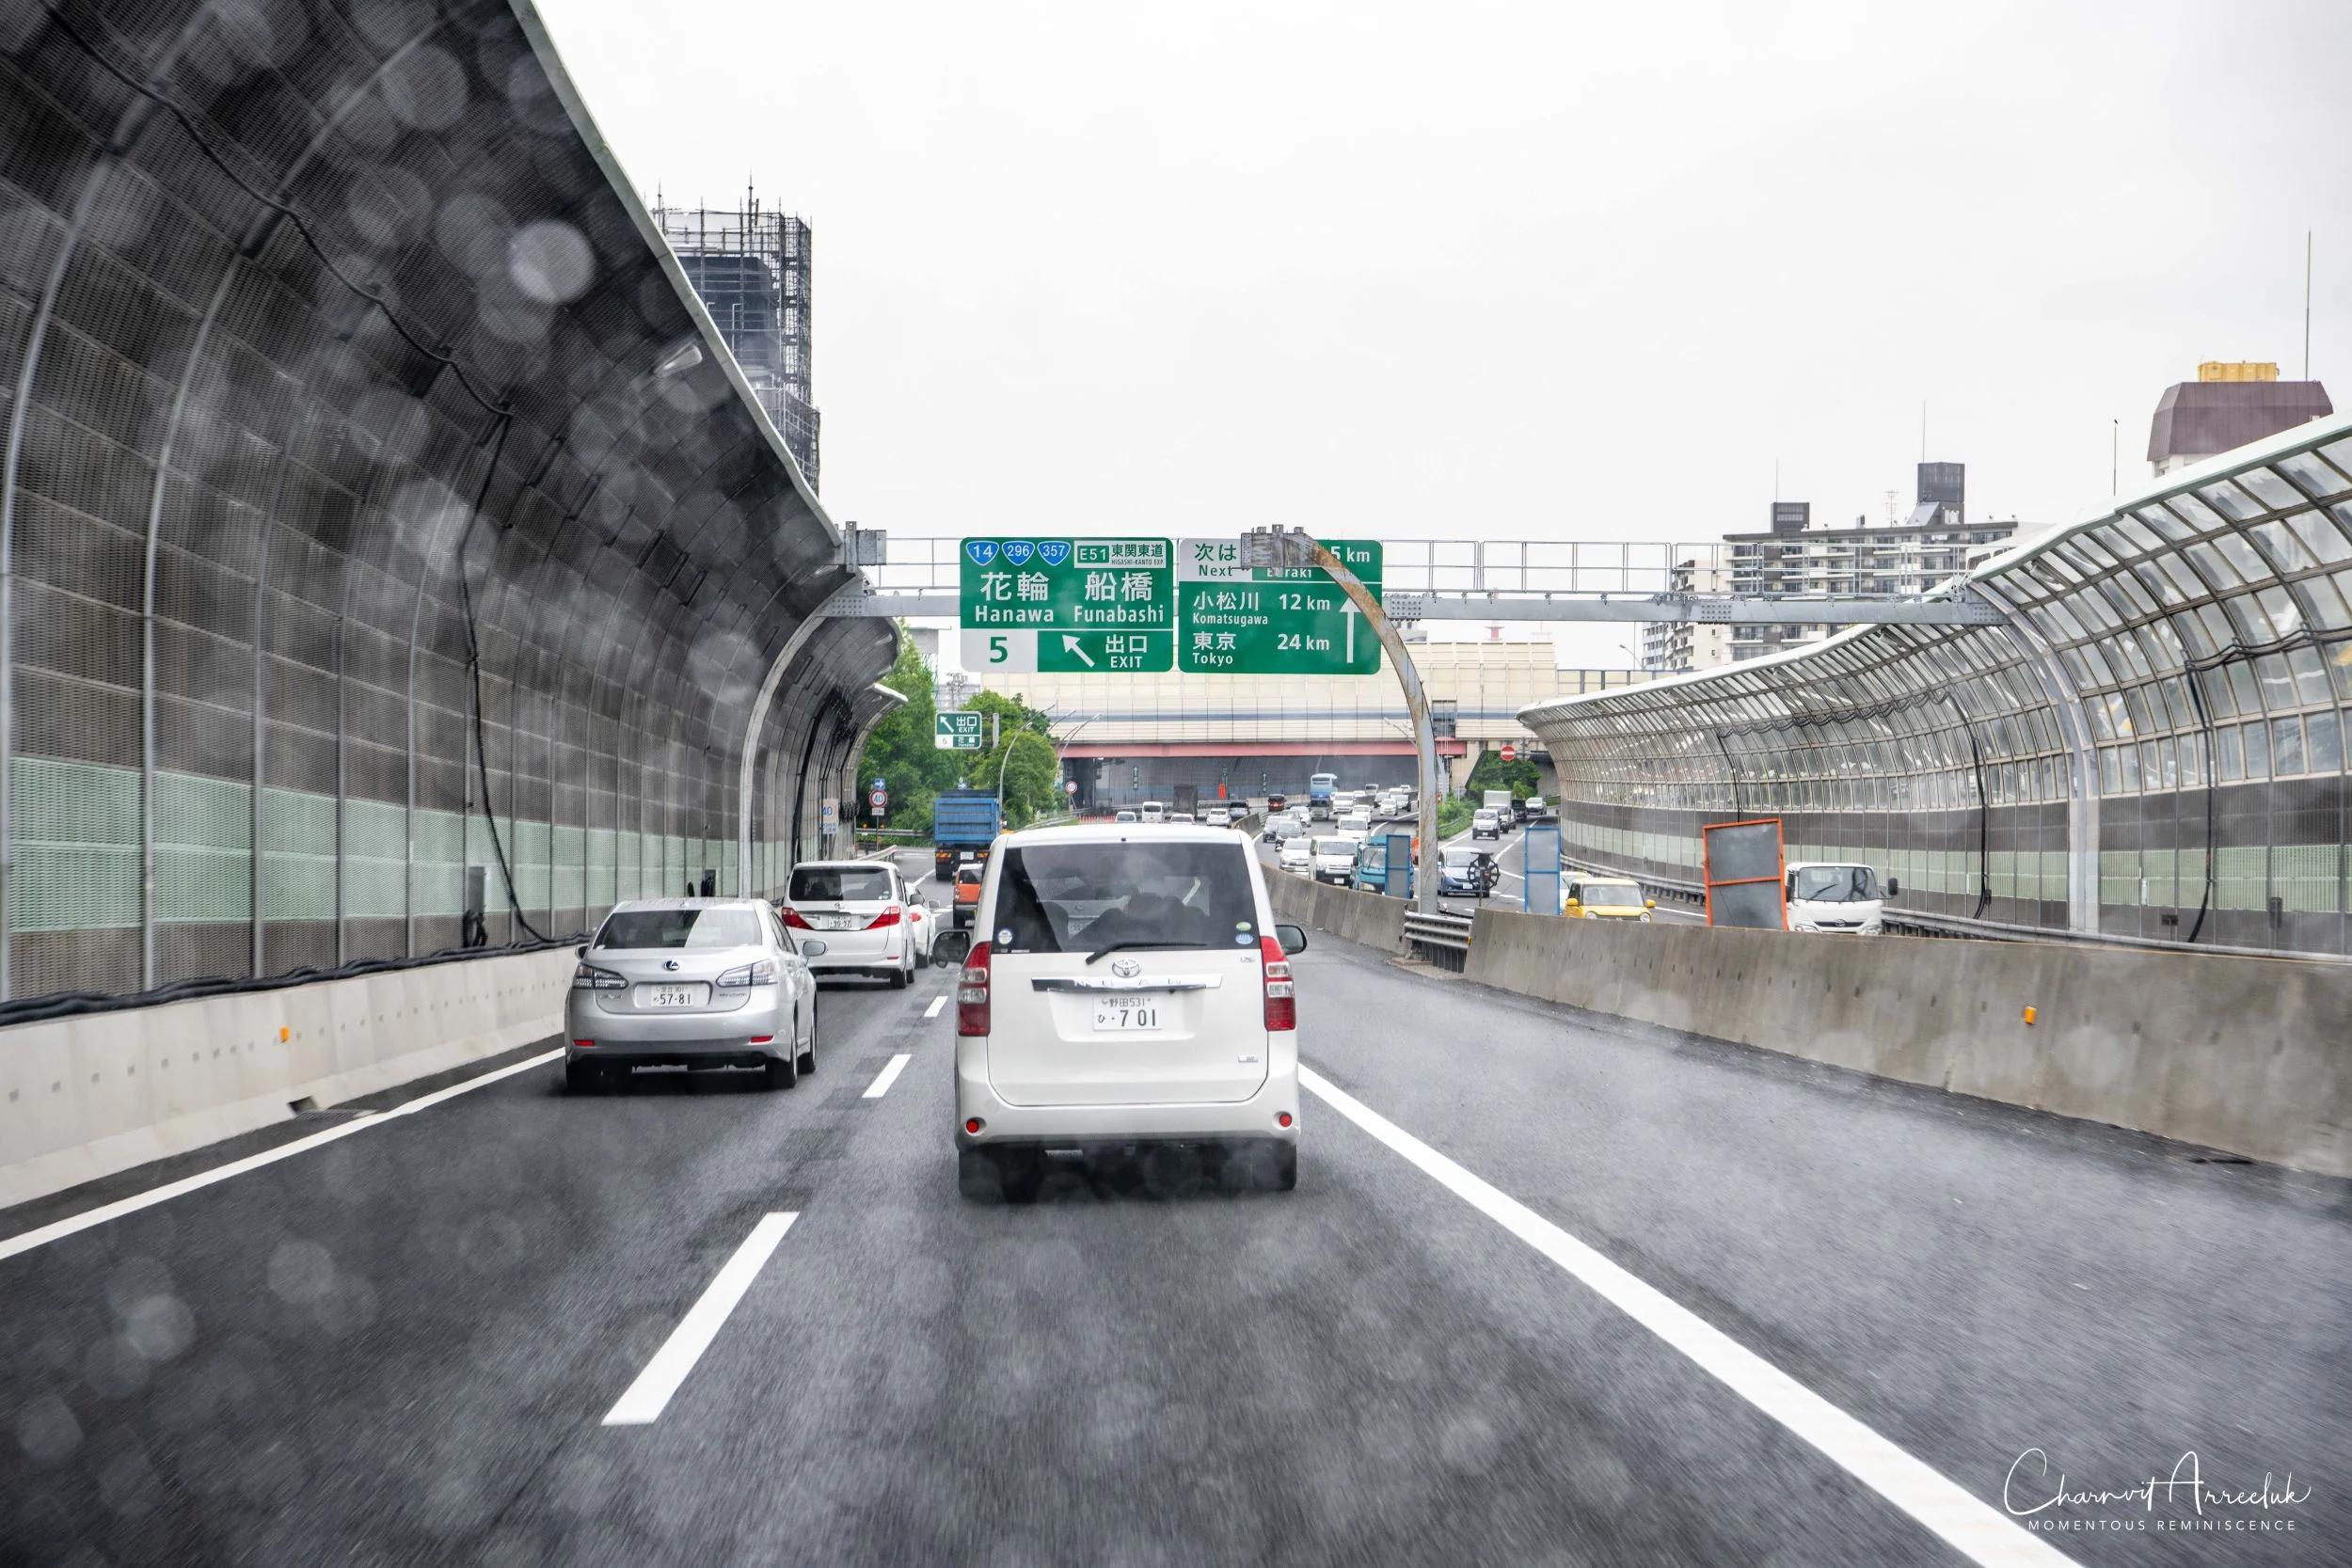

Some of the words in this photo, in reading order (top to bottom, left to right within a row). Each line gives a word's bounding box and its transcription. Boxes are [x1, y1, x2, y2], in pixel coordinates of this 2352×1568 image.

[974, 545, 993, 558] 14
[1008, 545, 1030, 557] 296
[1042, 545, 1065, 557] 357
[1080, 548, 1106, 561] E51
[1111, 544, 1164, 557] 東関東道
[1194, 543, 1237, 562] 次は
[1346, 546, 1371, 562] km
[1199, 564, 1233, 577] Next
[980, 571, 1050, 602] 花輪
[1085, 571, 1153, 602] 船橋
[1193, 591, 1260, 611] 小松川
[1279, 594, 1302, 610] 12
[1307, 594, 1330, 610] km
[975, 605, 1055, 623] Hanawa
[1074, 604, 1164, 623] Funabashi
[1192, 612, 1268, 627] Komatsugawa
[1104, 633, 1148, 654] 出口
[1192, 631, 1237, 651] 東京
[1277, 633, 1301, 651] 24
[1306, 634, 1330, 651] km
[990, 636, 1009, 663] 5
[1110, 656, 1143, 669] EXIT
[1192, 652, 1233, 667] Tokyo
[956, 716, 977, 727] 出口
